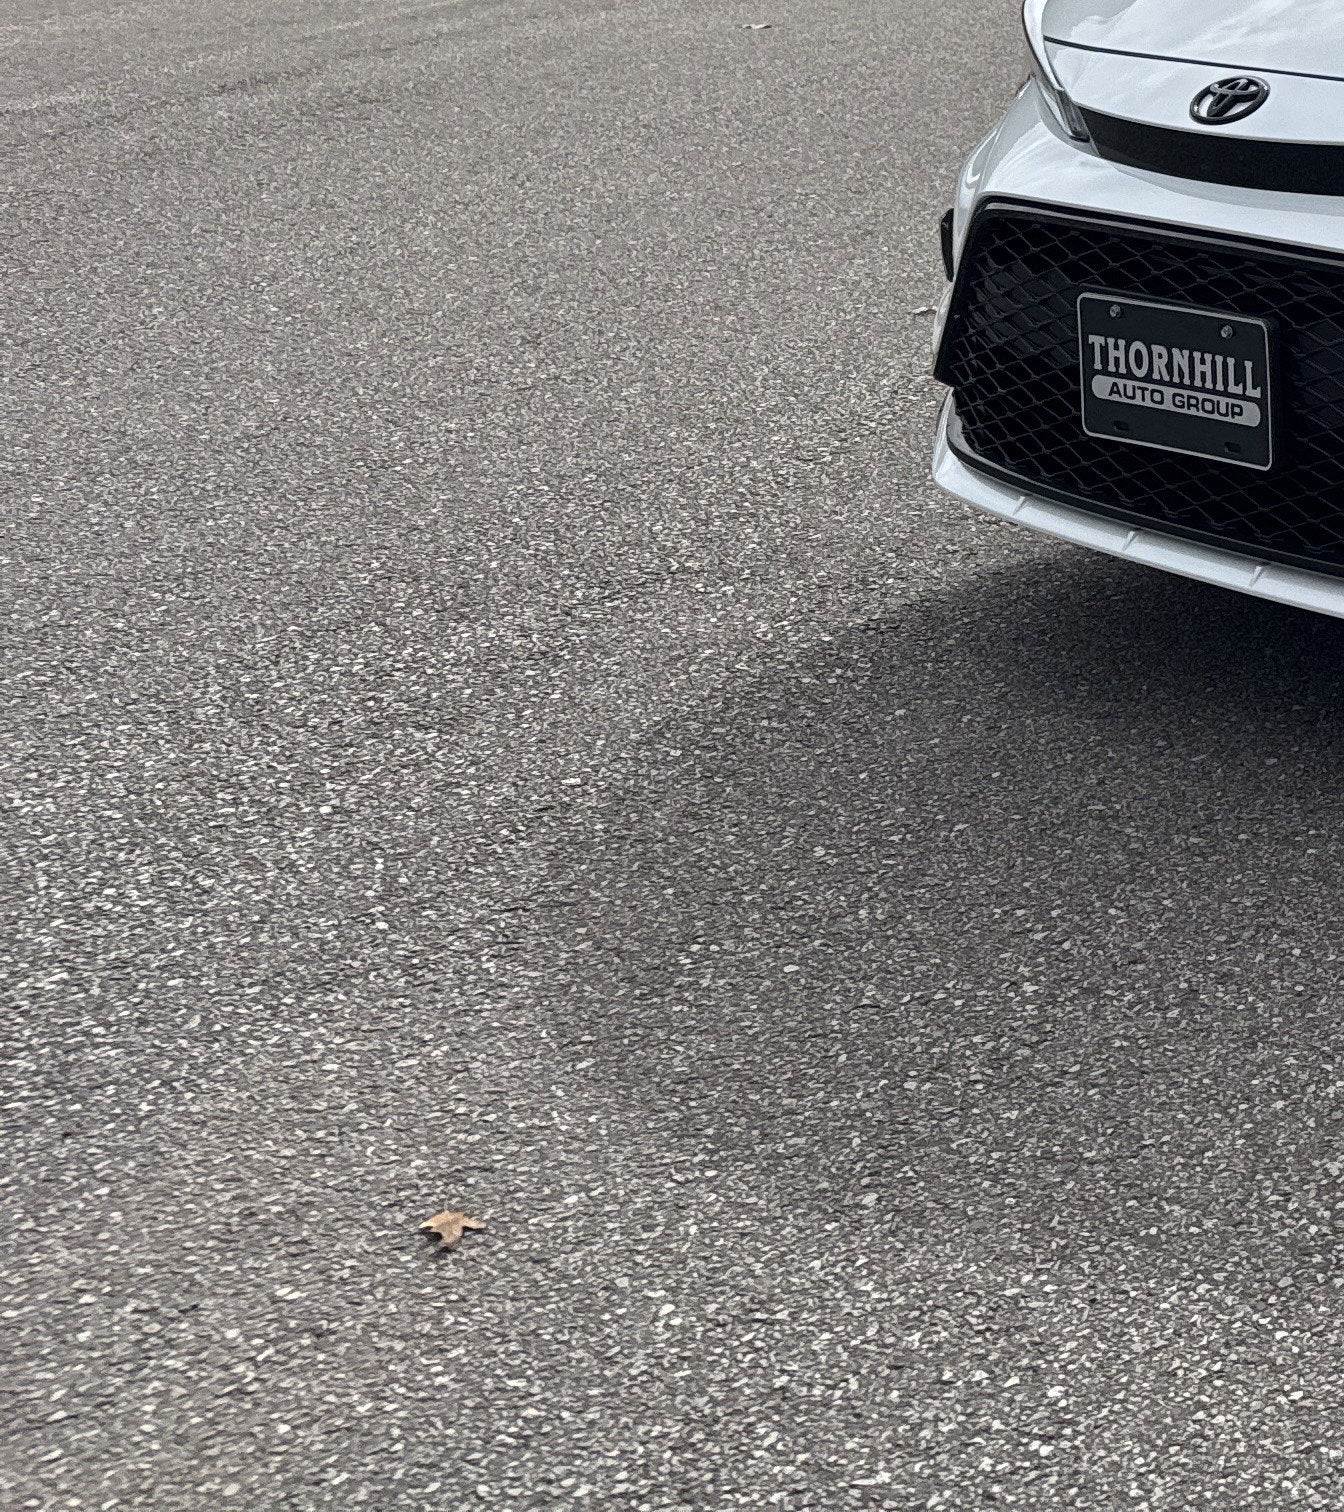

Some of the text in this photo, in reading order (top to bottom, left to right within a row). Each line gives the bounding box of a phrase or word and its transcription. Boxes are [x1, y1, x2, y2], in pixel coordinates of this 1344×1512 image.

[1088, 334, 1262, 398] THORNHILL
[1108, 381, 1244, 419] AUTO GROUP
